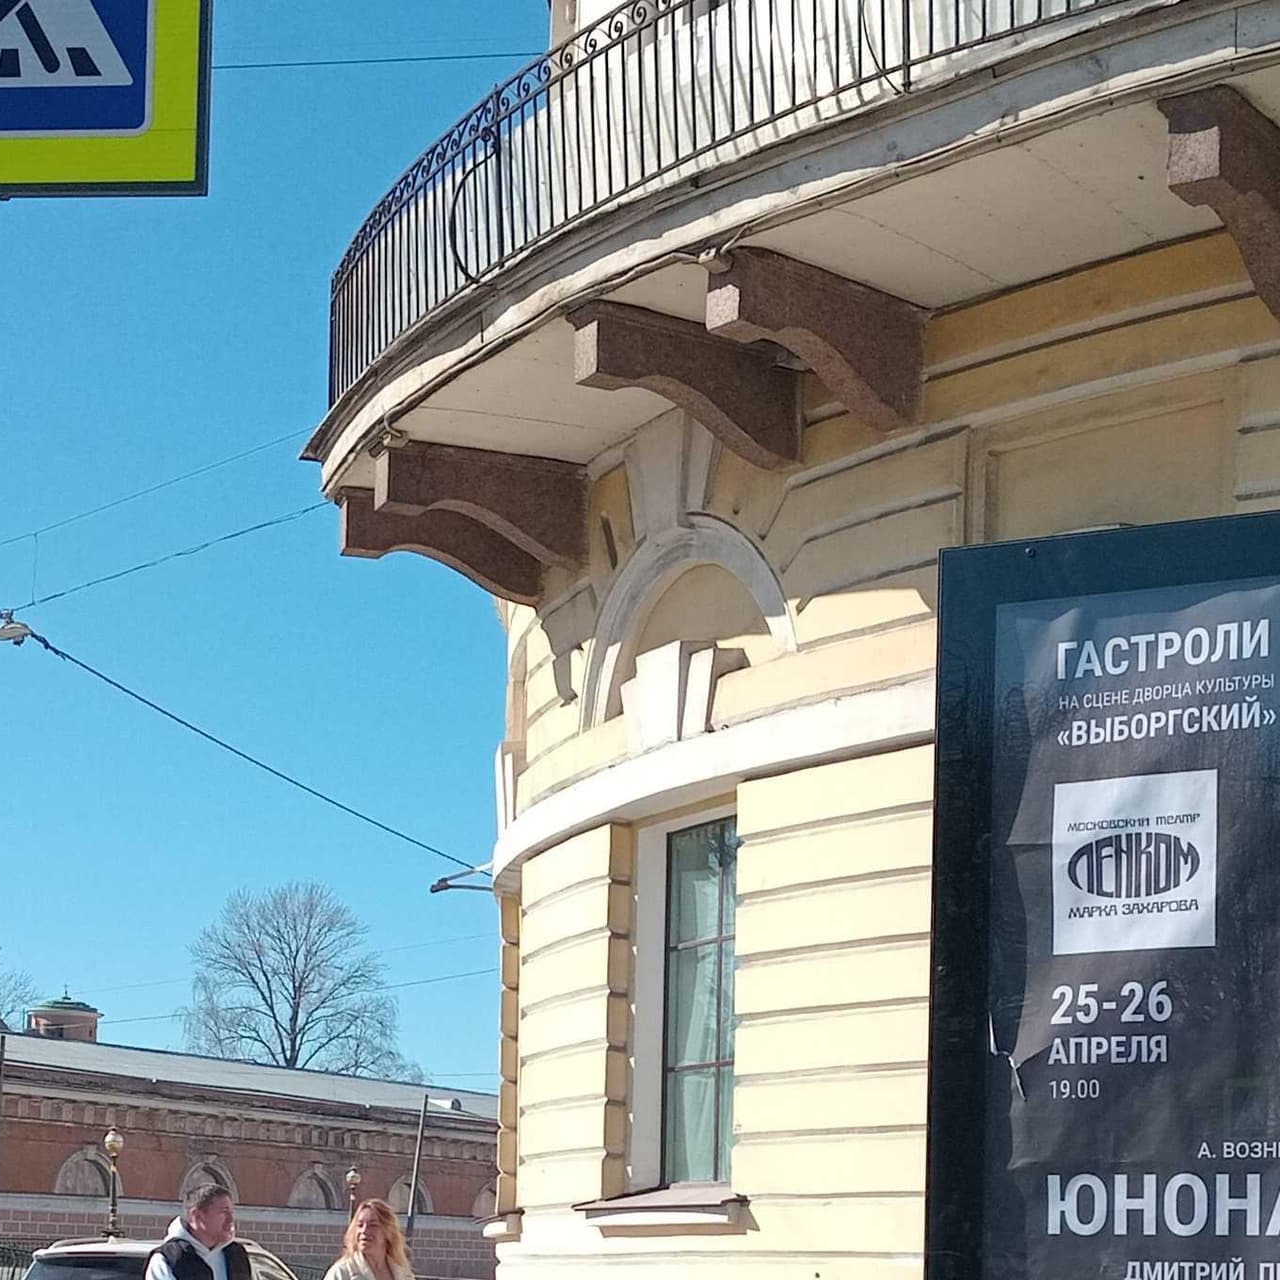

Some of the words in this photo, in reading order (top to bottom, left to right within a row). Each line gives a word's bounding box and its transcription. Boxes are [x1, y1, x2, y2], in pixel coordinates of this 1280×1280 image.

[1057, 619, 1269, 679] ГАСТРОЛИ
[1059, 695, 1080, 709] НА
[1083, 689, 1129, 709] СЦЕНЕ
[1132, 682, 1191, 704] ДВОРЦА
[1196, 673, 1274, 694] КУЛЬТУРЫ
[1057, 695, 1277, 746] «ВЫБОРГСКИЙ»
[1067, 832, 1200, 898] ЛЕНКОМ
[1068, 905, 1118, 919] МАРКА
[1122, 899, 1199, 915] ЗАХАРОВА
[1050, 980, 1173, 1025] 25-26
[1048, 1034, 1168, 1065] АПРЕЛЯ
[1049, 1079, 1100, 1099] 19.00
[1197, 1141, 1216, 1159] А.
